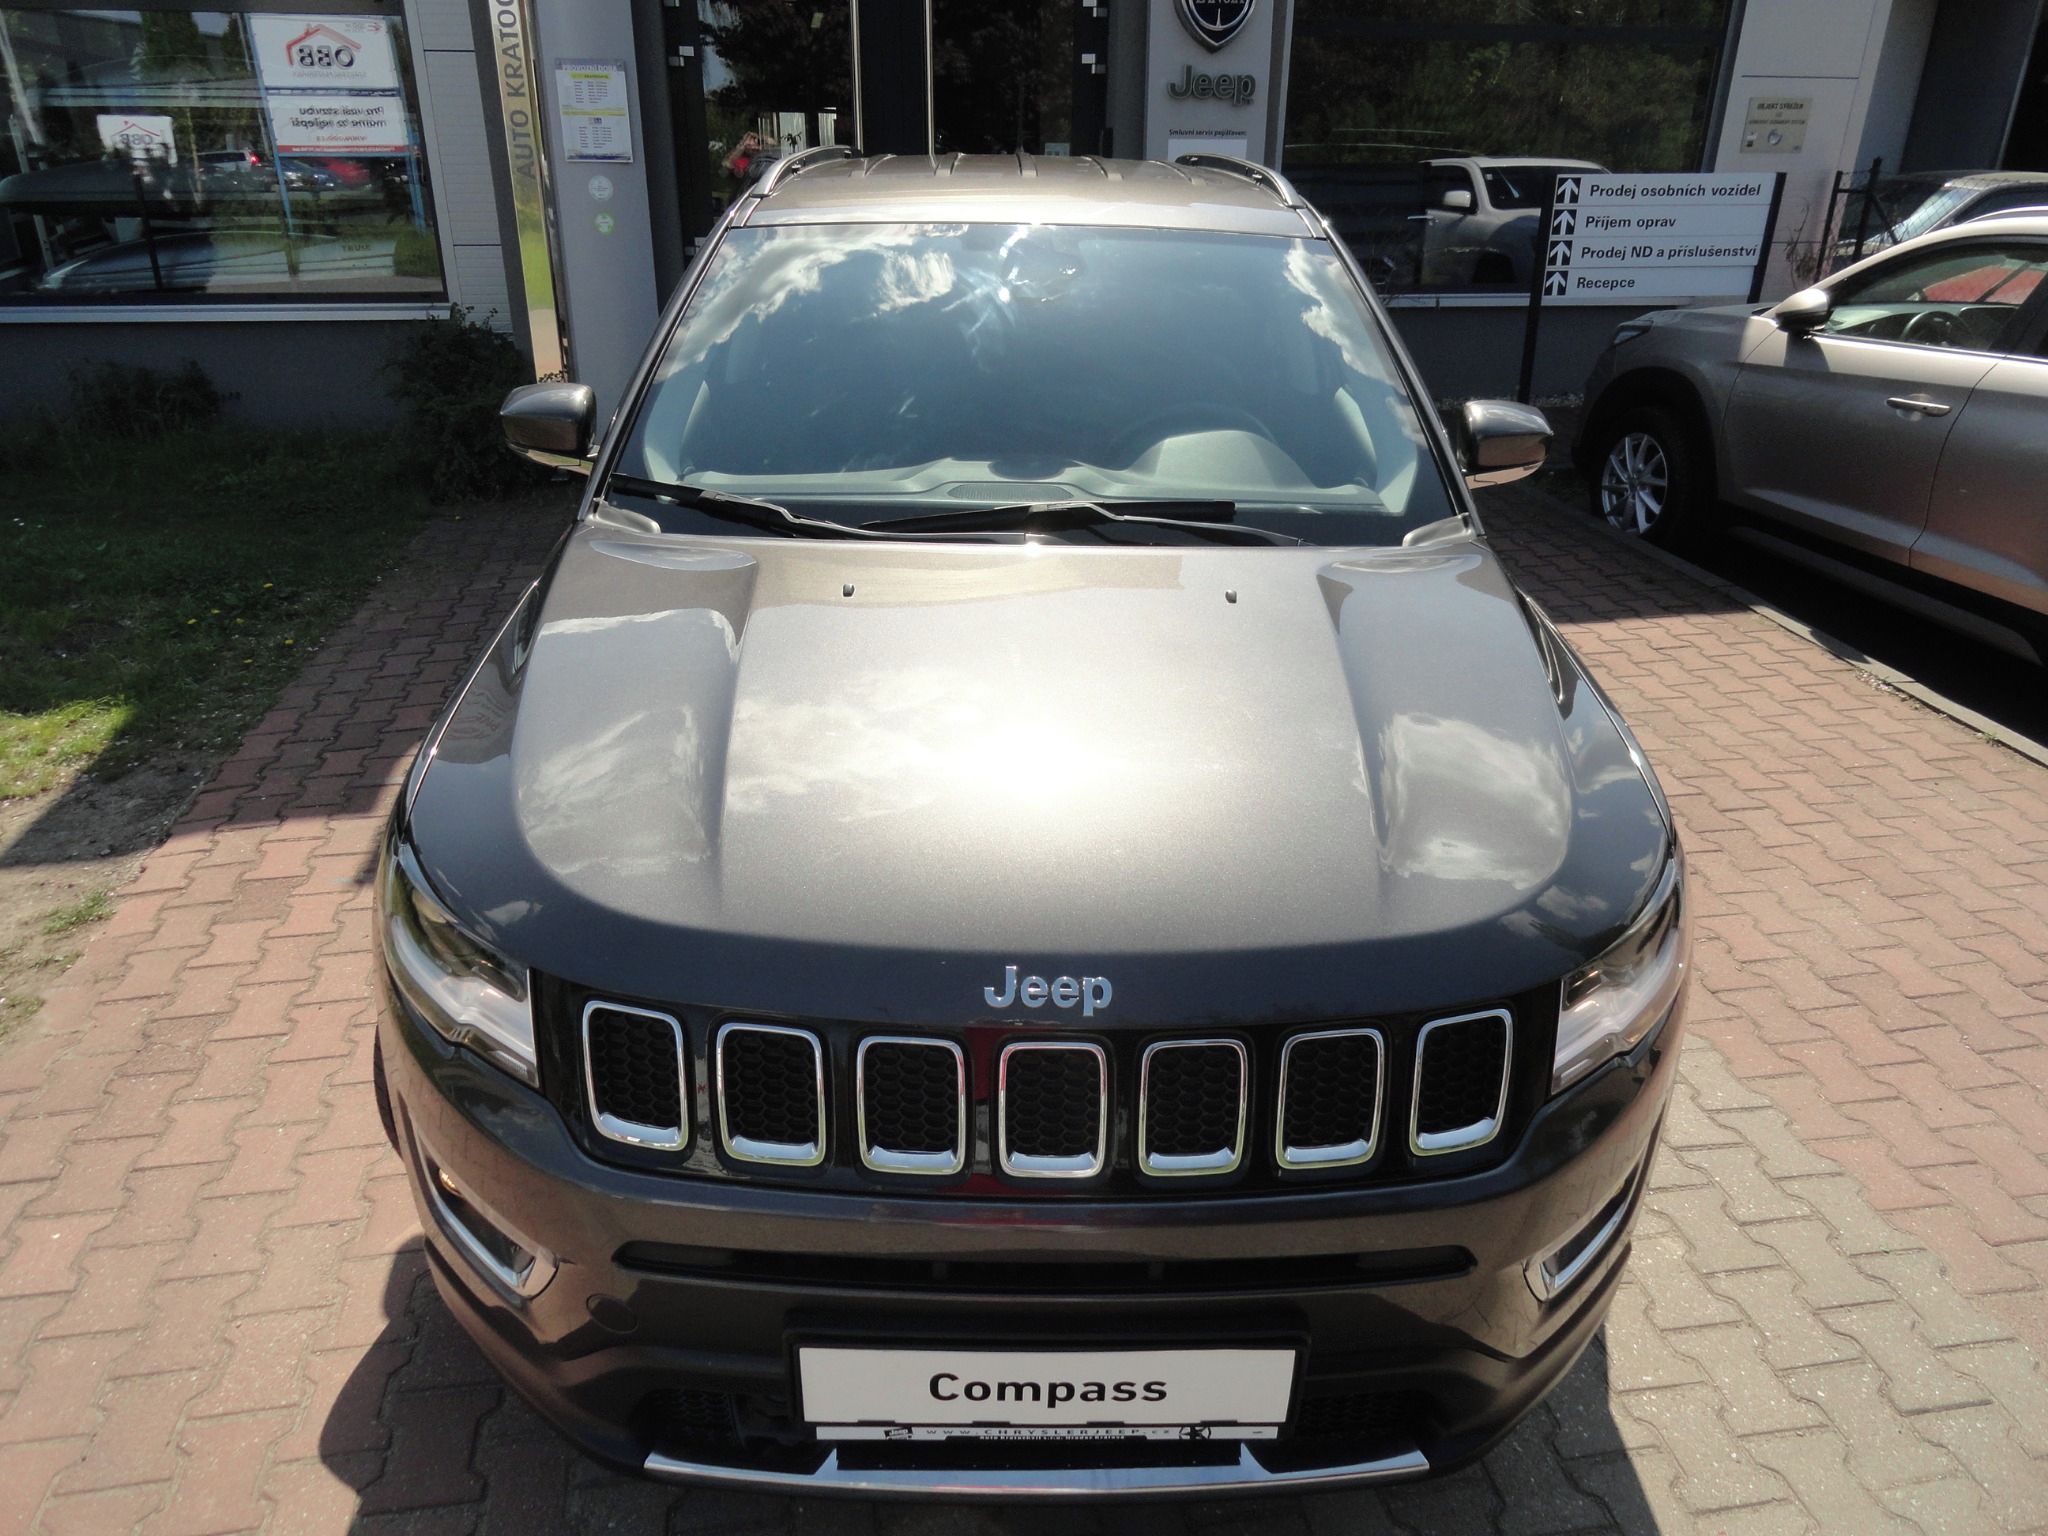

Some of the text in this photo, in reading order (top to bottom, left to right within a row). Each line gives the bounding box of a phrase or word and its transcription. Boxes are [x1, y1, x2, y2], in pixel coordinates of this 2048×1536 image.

[1167, 64, 1256, 107] Jeep
[510, 109, 536, 180] AUTO
[1589, 184, 1762, 200] Prodej osobních vozidel
[1585, 215, 1676, 230] Příjem oprav
[1581, 245, 1758, 261] Prodej ND a příslušenství
[1577, 277, 1635, 291] Recepce
[984, 965, 1112, 1017] Jeep
[929, 1372, 1168, 1410] Compass
